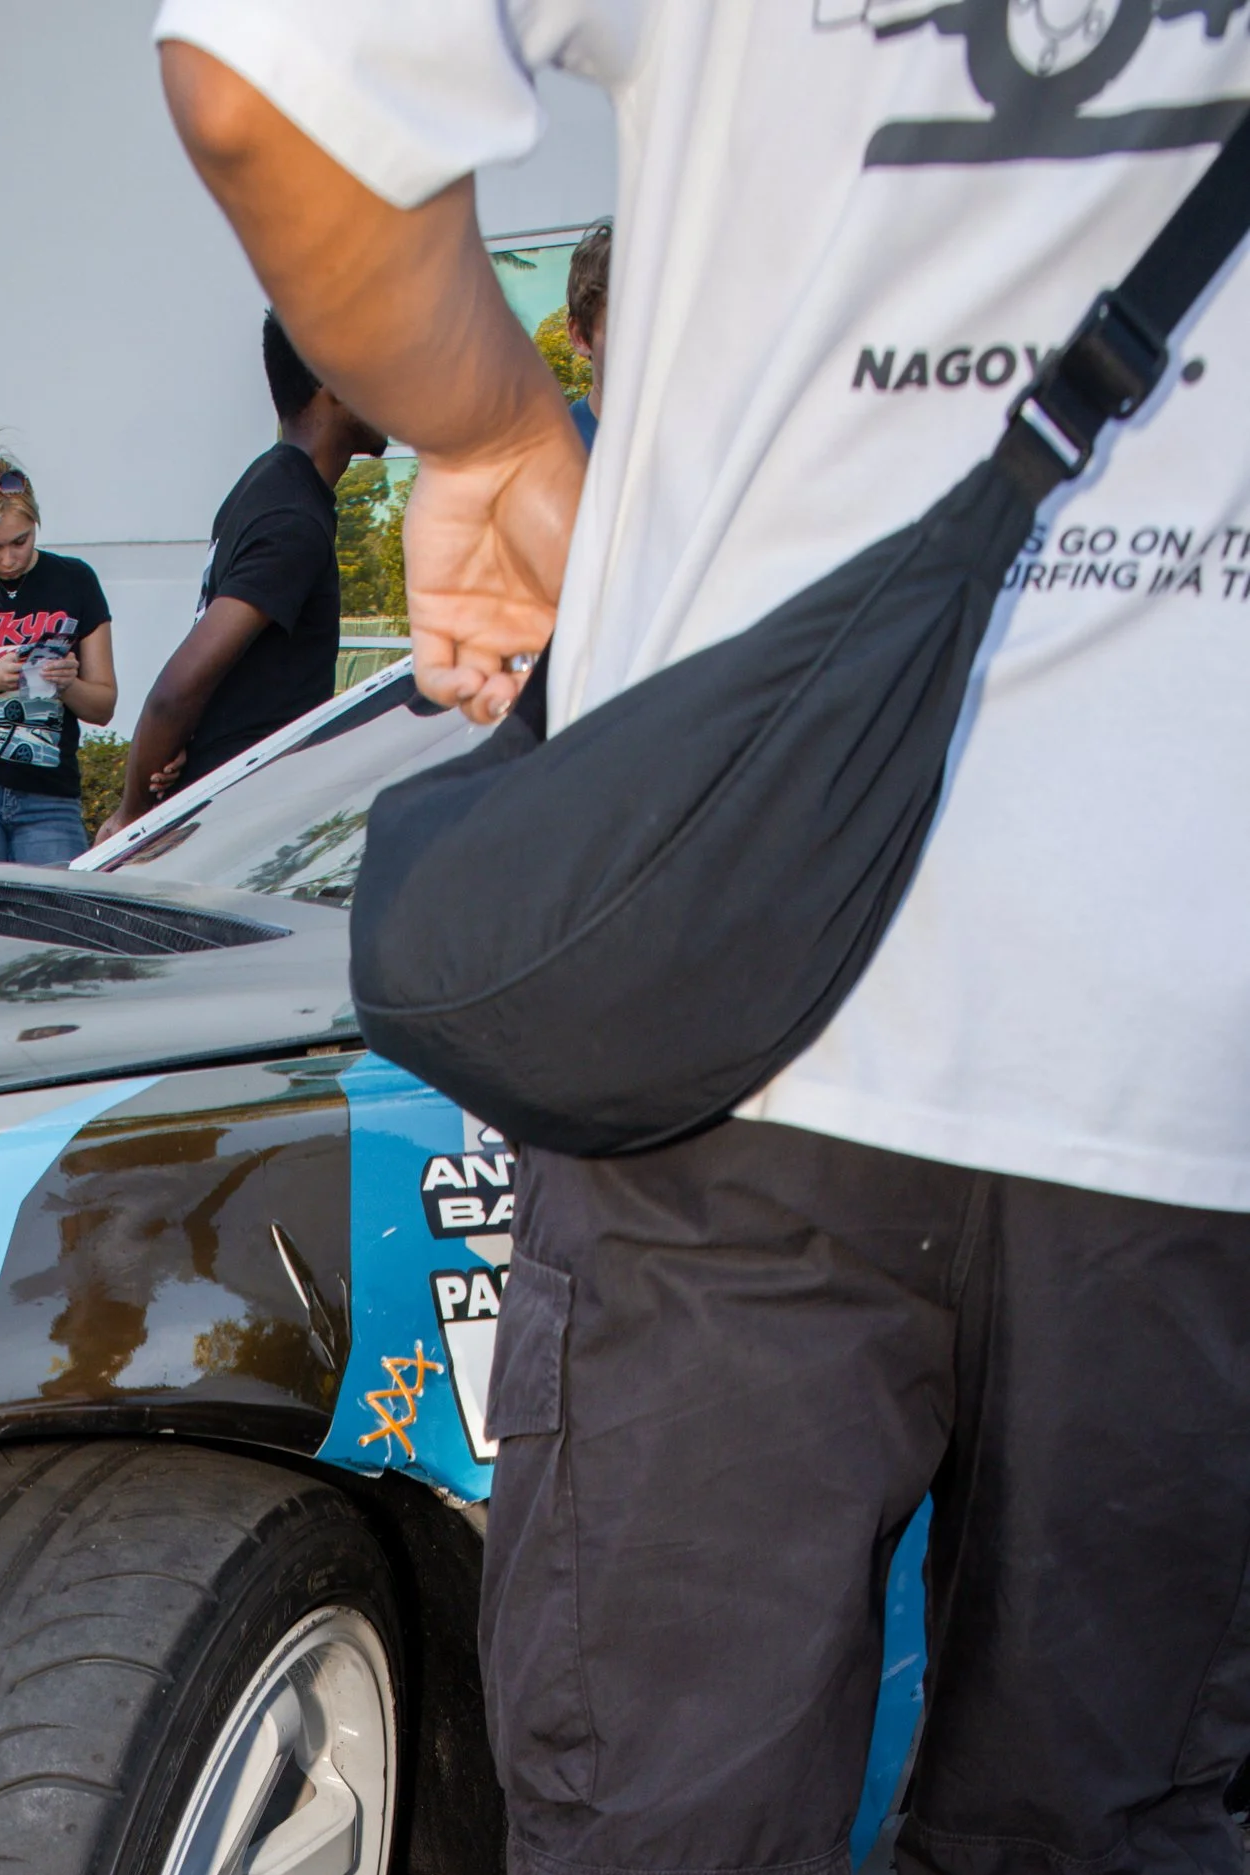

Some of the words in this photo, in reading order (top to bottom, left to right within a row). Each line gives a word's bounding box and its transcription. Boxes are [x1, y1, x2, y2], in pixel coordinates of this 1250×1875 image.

[1059, 526, 1118, 556] GO
[1130, 527, 1193, 560] ON
[422, 1152, 515, 1191] AN
[435, 1271, 510, 1320] PA
